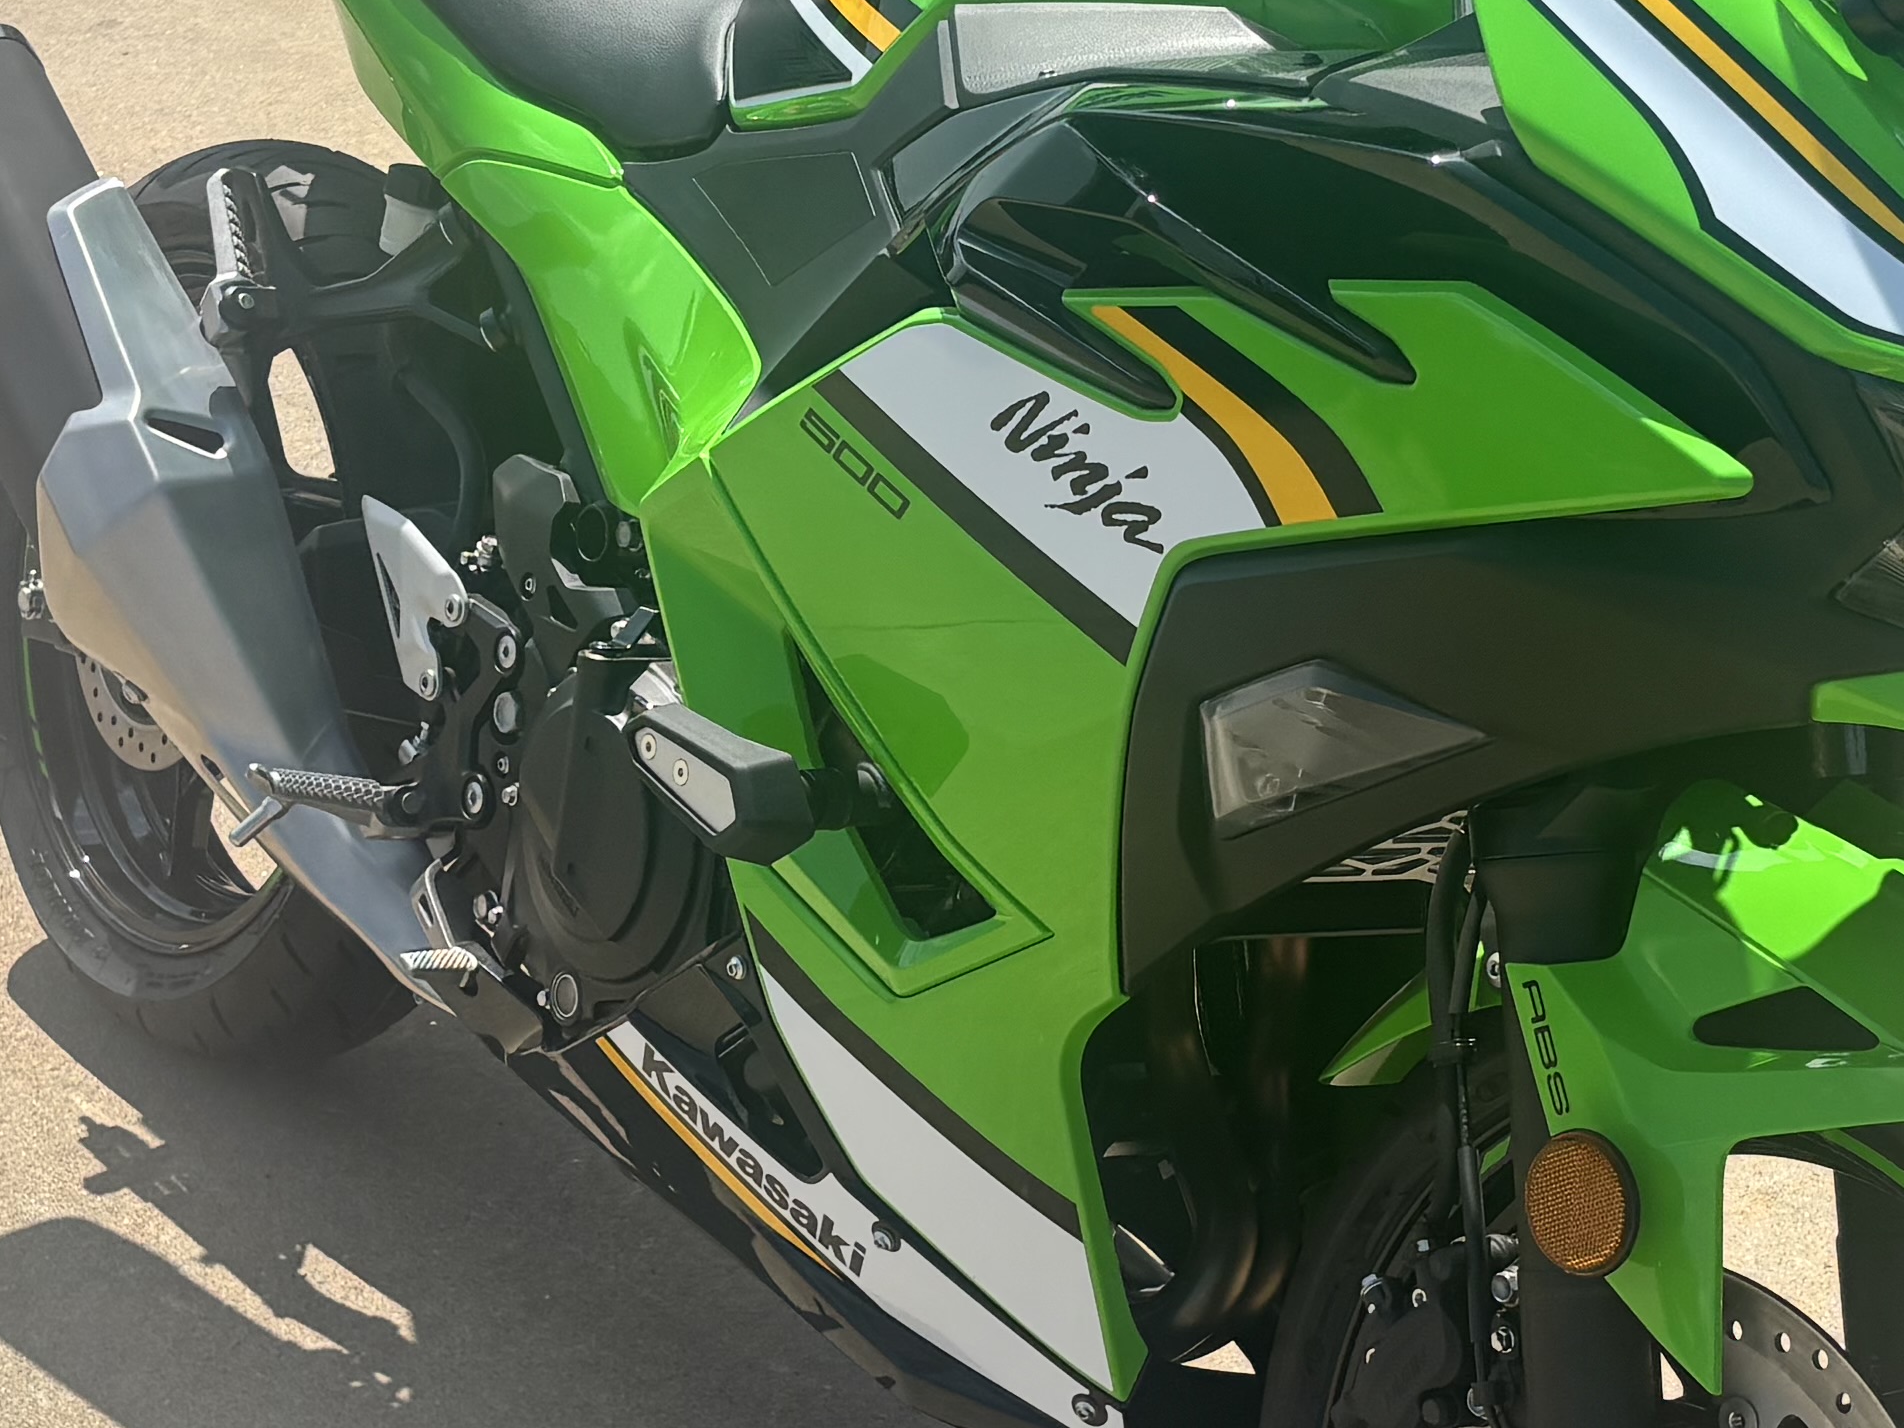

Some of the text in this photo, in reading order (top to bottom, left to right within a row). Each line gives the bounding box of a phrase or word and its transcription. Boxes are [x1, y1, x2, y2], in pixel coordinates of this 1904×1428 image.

[799, 407, 911, 520] 500
[990, 390, 1164, 554] Ninja
[1521, 979, 1570, 1116] ABS
[641, 1042, 867, 1278] Kawasaki
